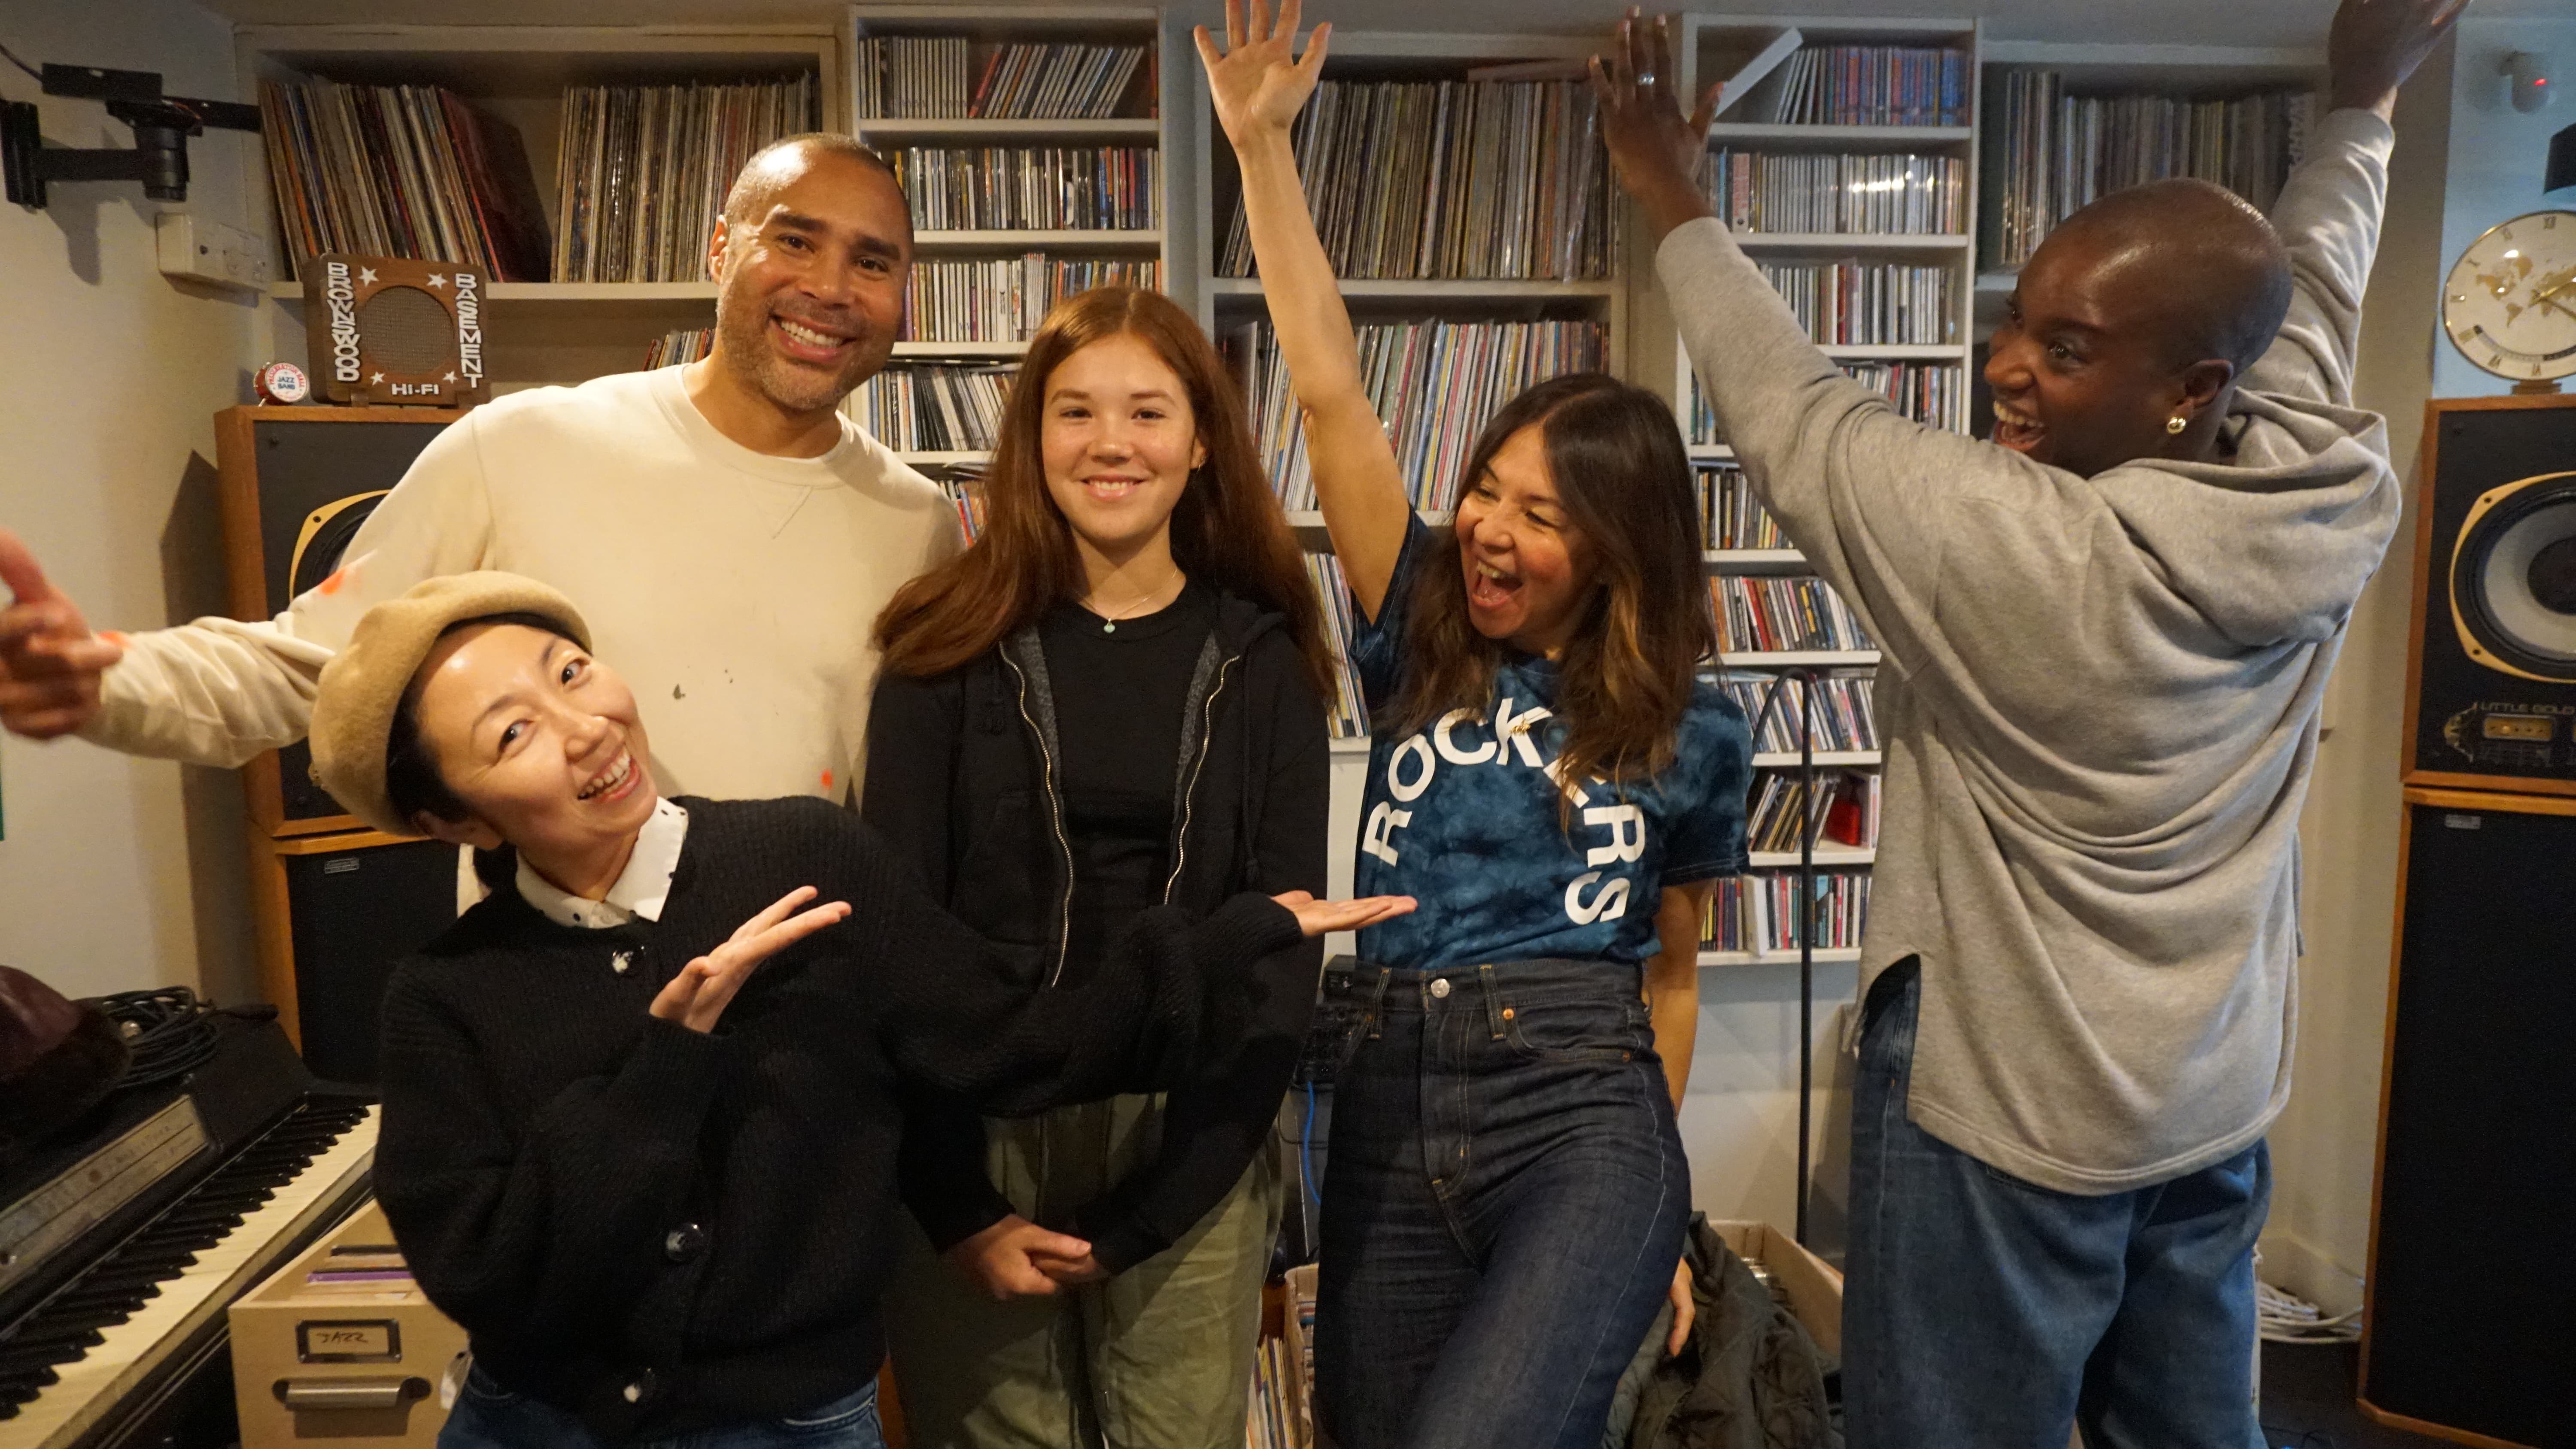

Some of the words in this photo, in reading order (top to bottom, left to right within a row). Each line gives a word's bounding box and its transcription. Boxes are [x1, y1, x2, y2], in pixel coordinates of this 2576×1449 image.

[328, 262, 360, 381] BROWNSWOOD
[455, 273, 482, 388] BASEMENT
[392, 383, 439, 395] HI-FI
[2481, 702, 2529, 713] LITTLE
[2533, 704, 2575, 715] GOLD
[316, 1331, 368, 1343] JAZZ
